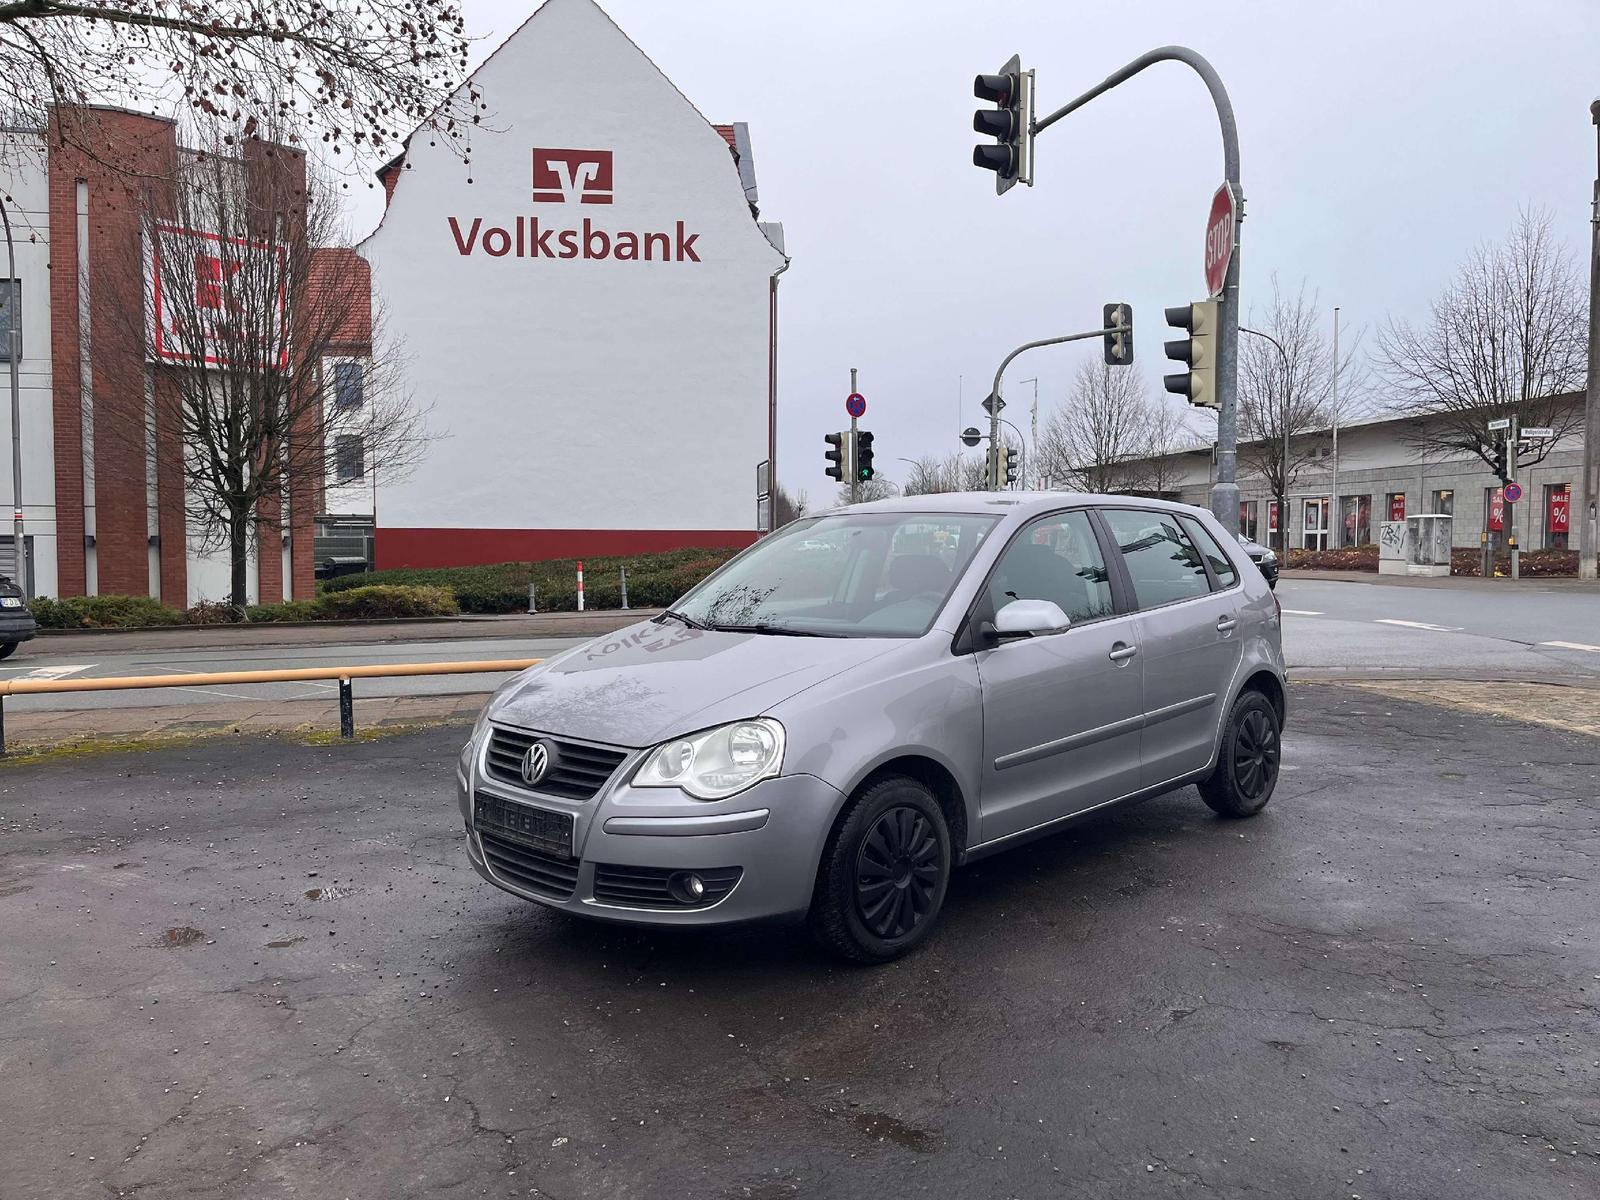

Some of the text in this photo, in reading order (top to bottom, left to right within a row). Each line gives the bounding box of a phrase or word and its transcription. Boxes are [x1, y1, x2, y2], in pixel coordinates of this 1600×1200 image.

[447, 216, 702, 263] Volksbank
[1208, 213, 1230, 269] STOP
[1552, 494, 1569, 503] SALE
